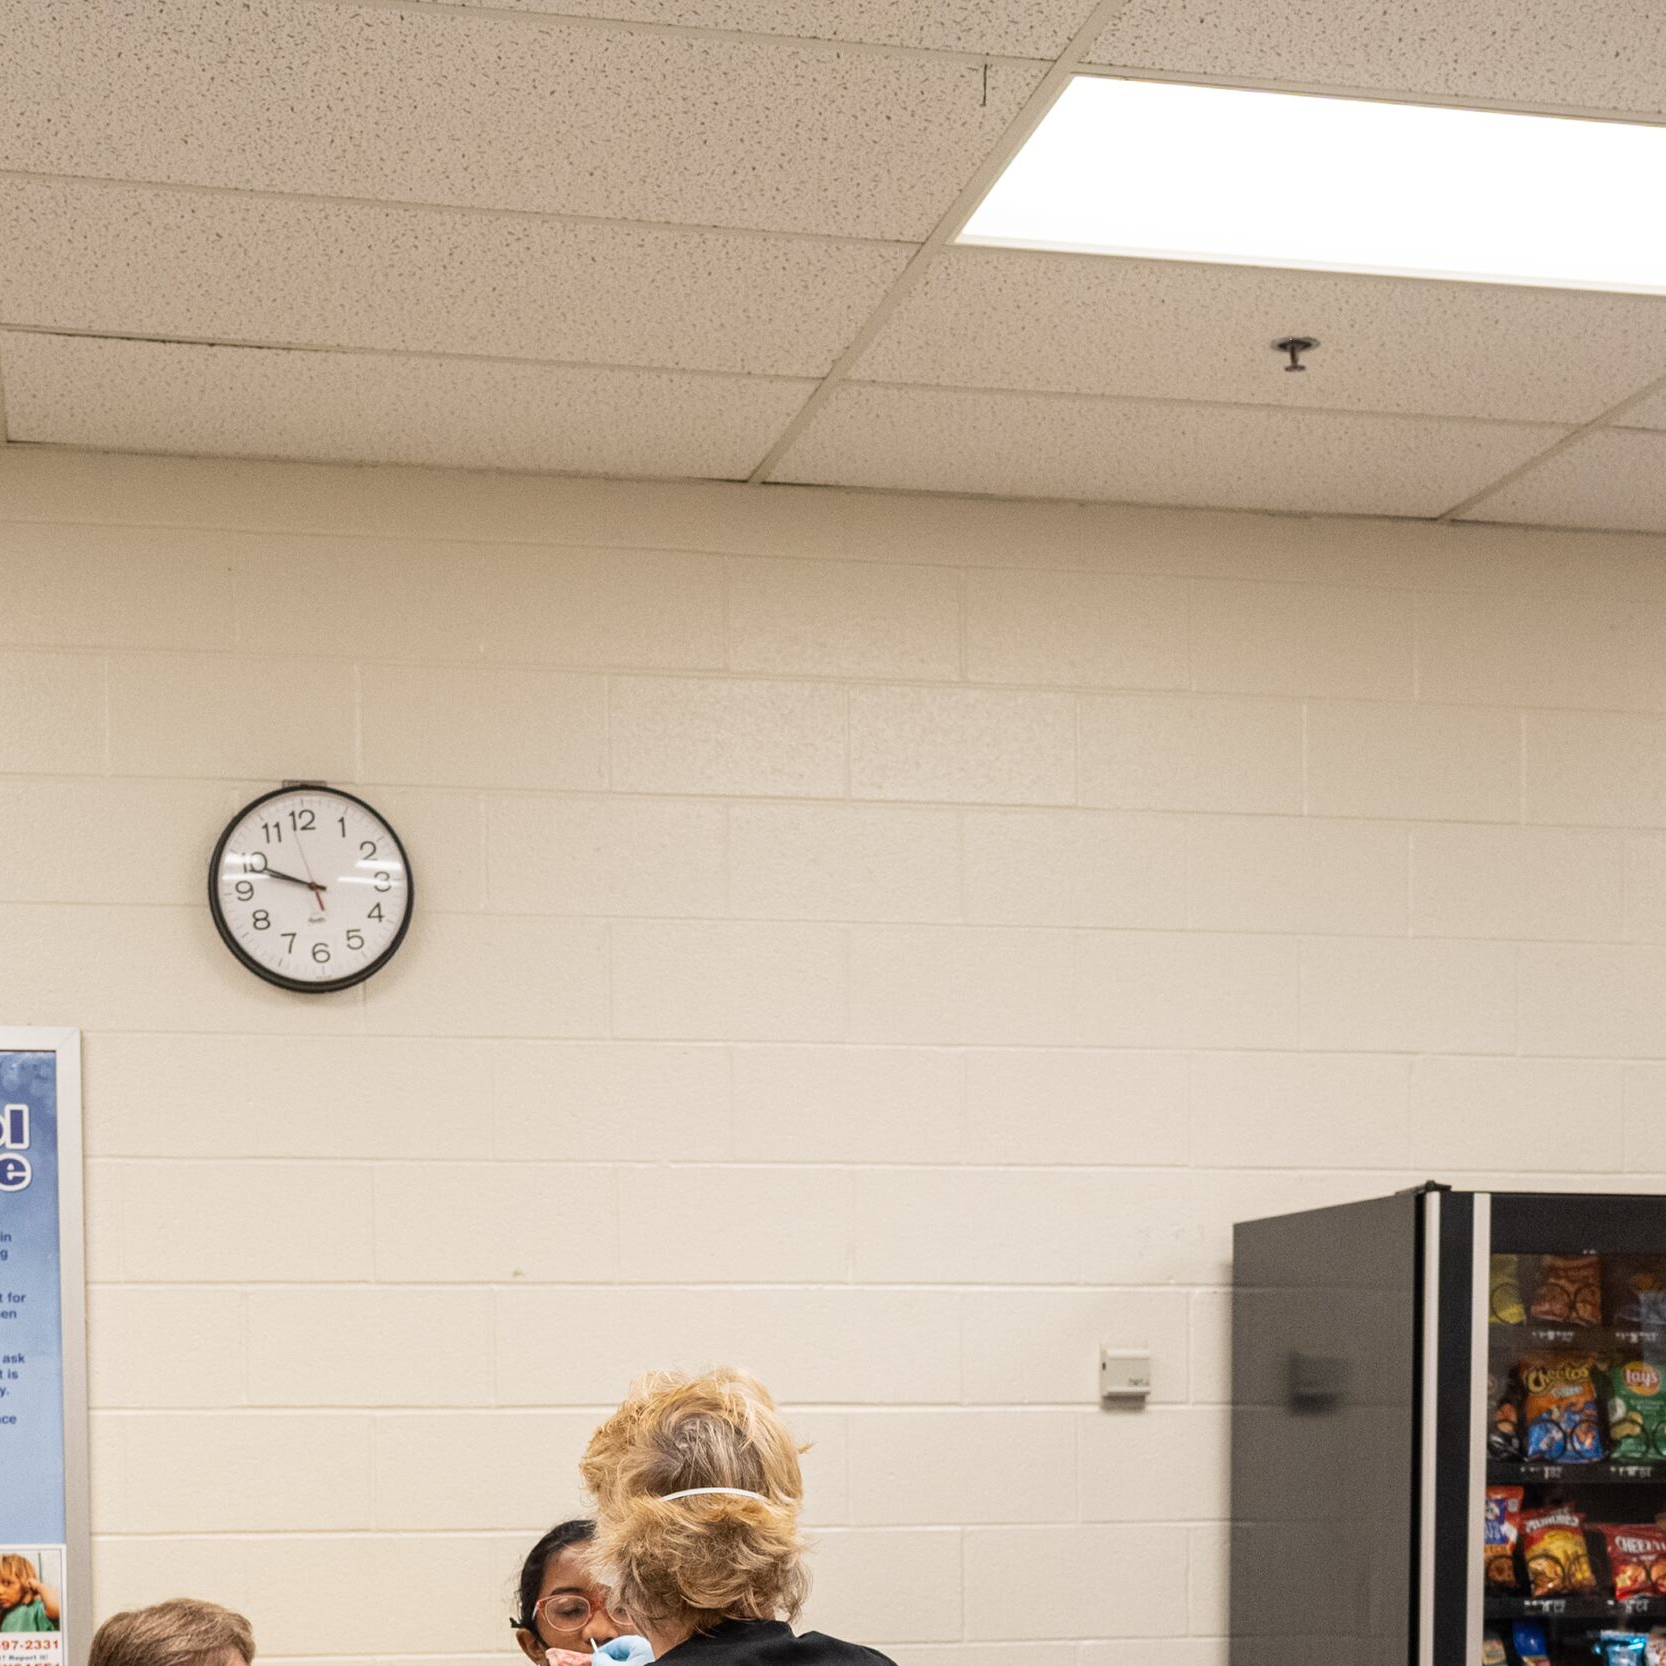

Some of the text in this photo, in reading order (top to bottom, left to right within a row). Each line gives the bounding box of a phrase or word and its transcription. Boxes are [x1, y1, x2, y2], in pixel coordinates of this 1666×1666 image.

[289, 809, 316, 831] 12
[337, 817, 346, 838] 1
[261, 821, 282, 843] 11
[359, 841, 378, 861] 2
[243, 852, 268, 873] 10
[235, 880, 254, 901] 9
[374, 871, 391, 892] 3
[252, 909, 271, 930] 8
[367, 902, 385, 923] 4
[281, 932, 297, 954] 7
[346, 929, 365, 950] 5
[312, 942, 331, 963] 6
[0, 1232, 11, 1242] in
[8, 1292, 26, 1303] for
